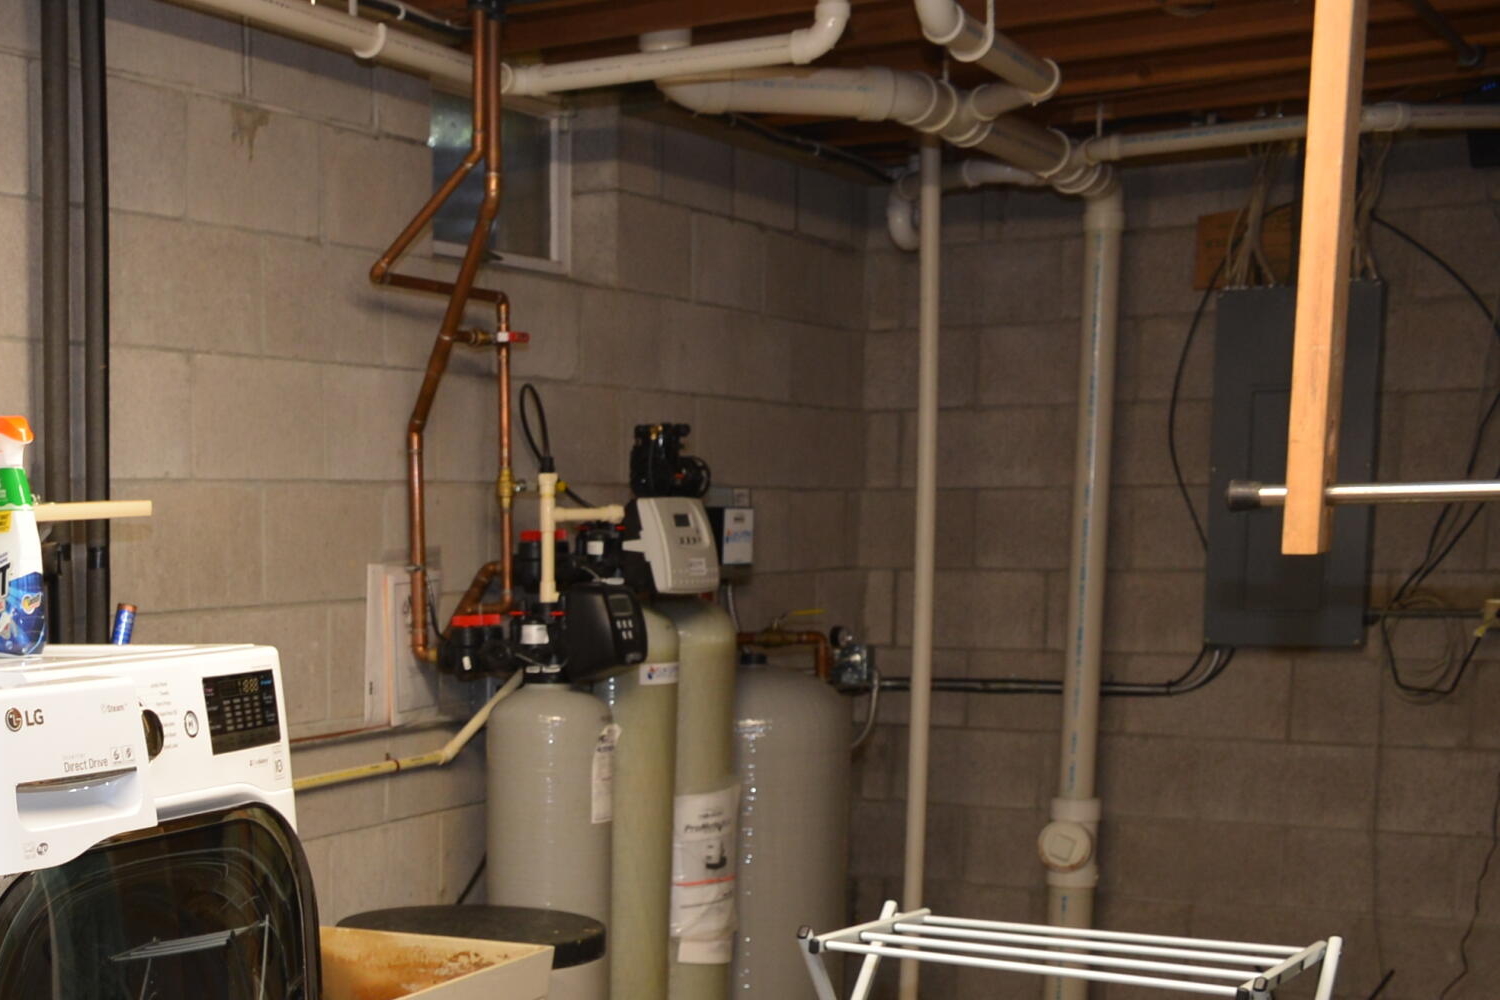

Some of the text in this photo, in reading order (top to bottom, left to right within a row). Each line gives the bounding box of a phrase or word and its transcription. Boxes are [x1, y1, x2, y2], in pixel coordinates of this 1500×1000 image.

[25, 708, 45, 726] LG
[63, 757, 109, 774] Direct Drive
